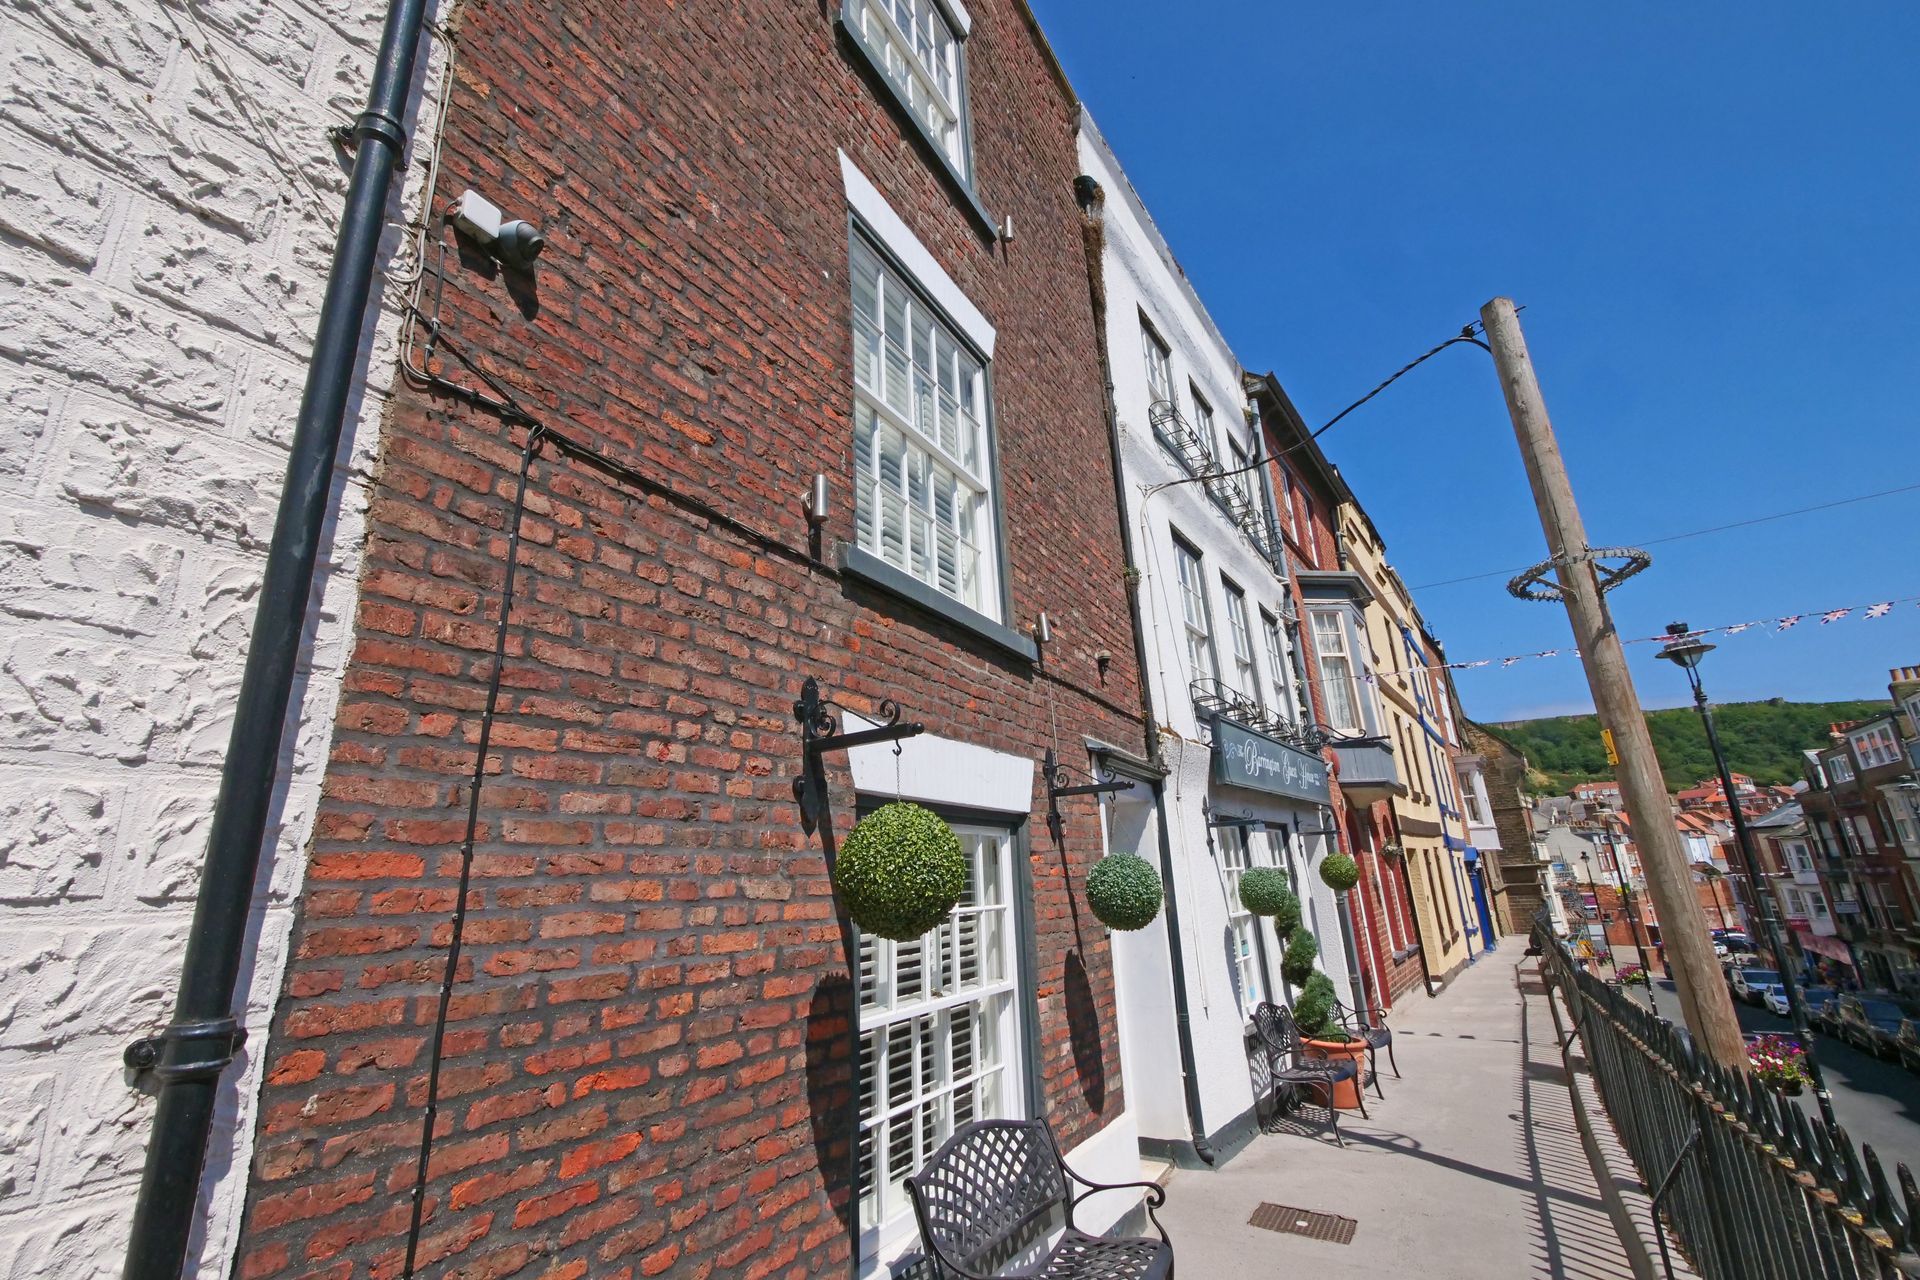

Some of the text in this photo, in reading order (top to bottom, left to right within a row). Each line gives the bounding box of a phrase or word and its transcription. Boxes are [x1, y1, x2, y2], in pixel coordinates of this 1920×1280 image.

[1244, 739, 1280, 777] Barrington
[1281, 750, 1298, 785] Guest
[1297, 758, 1315, 790] House
